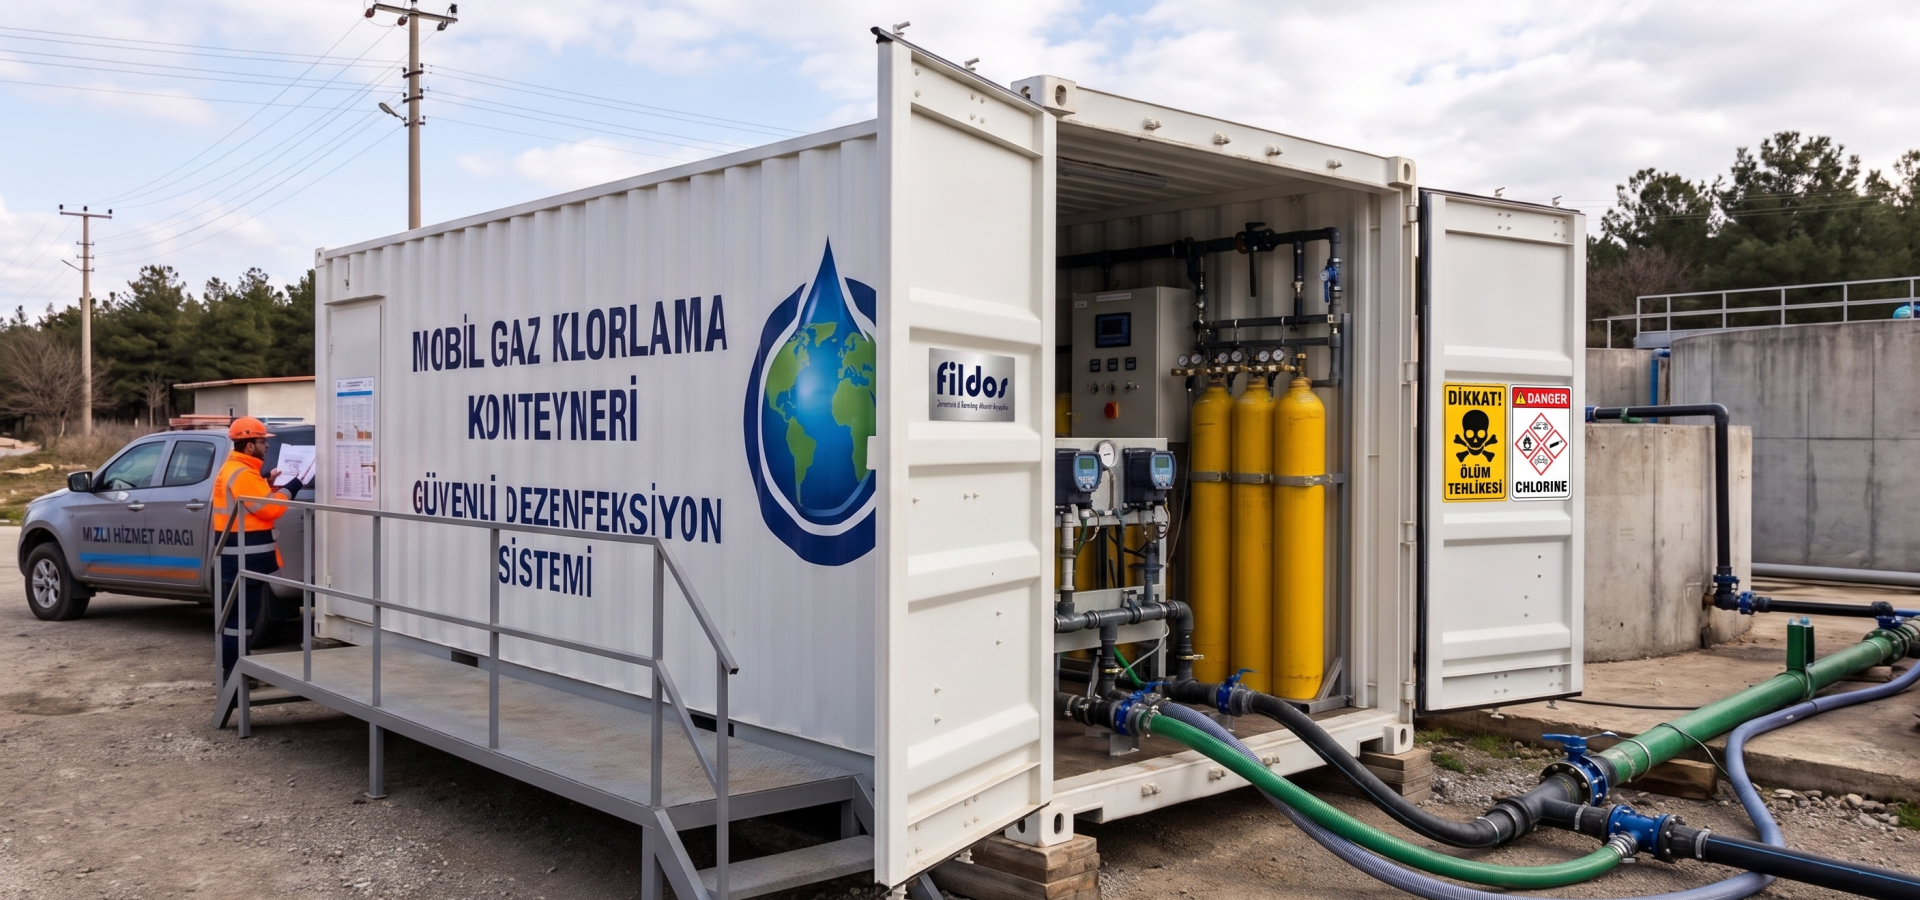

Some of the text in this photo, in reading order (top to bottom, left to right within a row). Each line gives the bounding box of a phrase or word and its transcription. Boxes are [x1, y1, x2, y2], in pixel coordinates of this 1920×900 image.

[412, 294, 728, 373] MOBİL GAZ KLORLAMA
[936, 361, 1009, 399] fildos
[1448, 387, 1502, 407] DİKKAT!
[1527, 392, 1568, 405] DANGER
[468, 374, 638, 442] KONTEYNERİ
[1460, 463, 1491, 479] ÖLÜM
[1448, 479, 1503, 495] TEHLİKESİ
[1515, 480, 1568, 494] CHLORINE
[412, 471, 497, 522] GÜVENLİ
[506, 482, 722, 545] DEZENFEKSİYON
[113, 524, 155, 545] HİZMET
[498, 536, 592, 598] SİSTEMİ
